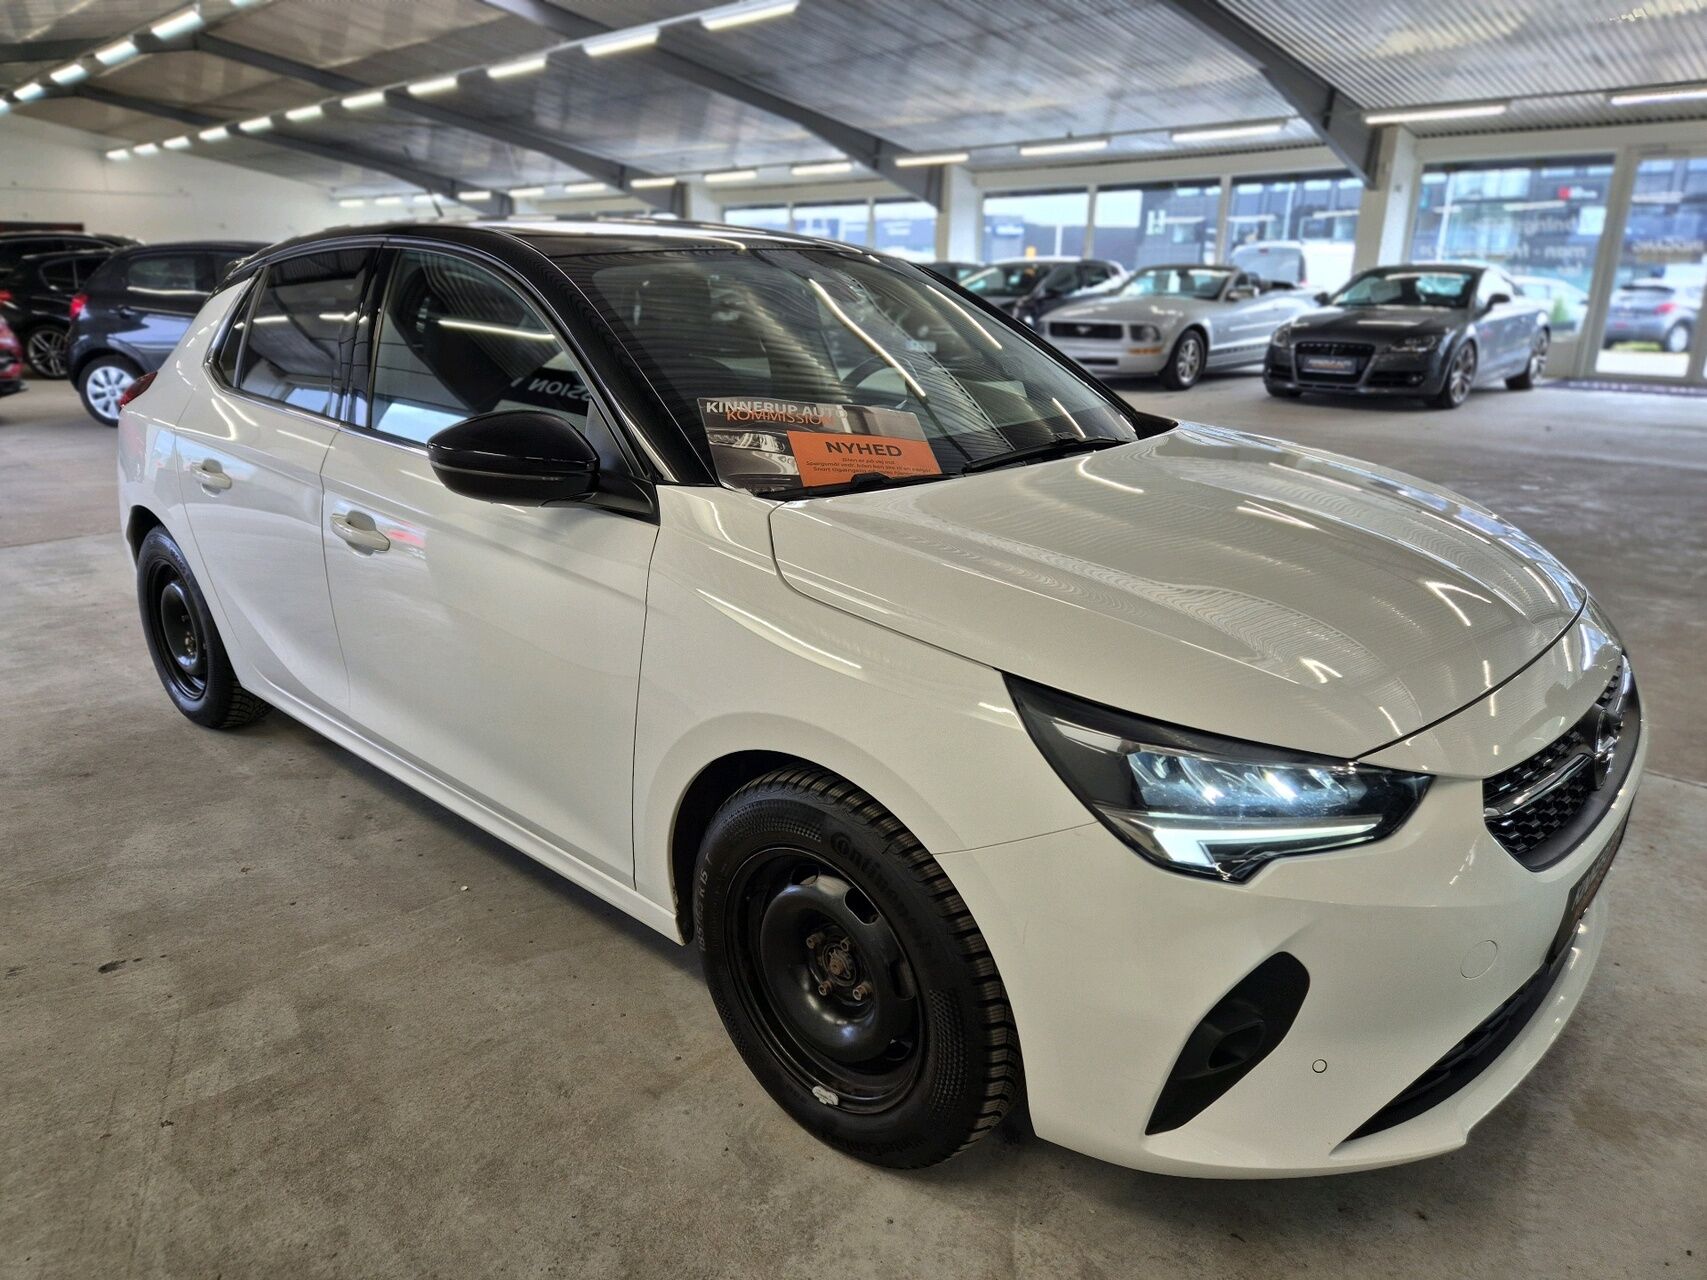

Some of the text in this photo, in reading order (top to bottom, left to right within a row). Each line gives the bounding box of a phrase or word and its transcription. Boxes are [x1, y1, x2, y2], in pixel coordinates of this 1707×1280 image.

[706, 401, 848, 419] KINNERUP AUTO
[825, 441, 903, 457] NYHED
